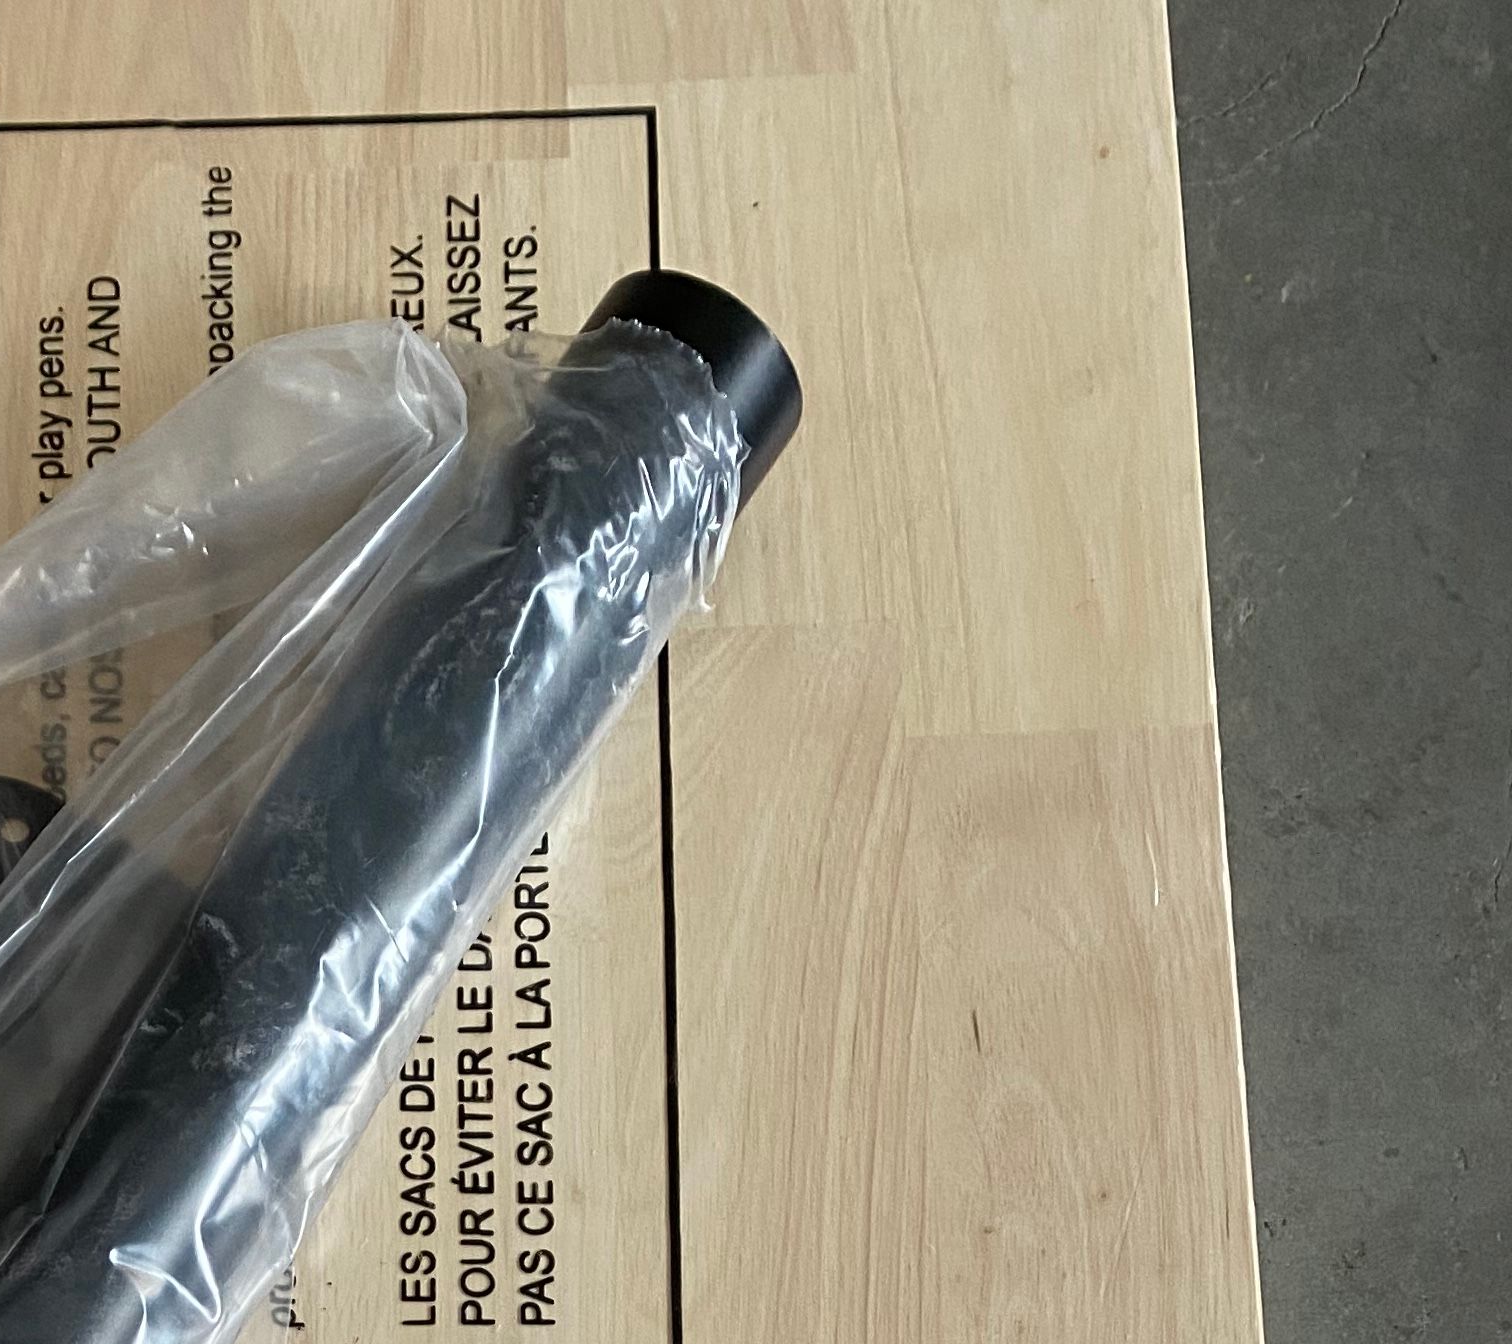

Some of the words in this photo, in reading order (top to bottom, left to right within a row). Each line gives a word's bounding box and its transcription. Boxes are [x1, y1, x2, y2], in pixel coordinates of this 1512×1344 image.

[201, 164, 233, 217] the
[38, 305, 72, 397] pens.
[87, 274, 121, 356] AND
[31, 410, 72, 479] play
[456, 985, 493, 1033] LE
[515, 977, 552, 1029] LA
[398, 1057, 435, 1112] DE
[508, 1040, 552, 1070] À
[449, 1046, 495, 1193] ÉVITER
[517, 1081, 553, 1166] SAC
[398, 1126, 436, 1236] SACS
[517, 1179, 554, 1235] CE
[399, 1248, 436, 1325] LES
[458, 1208, 496, 1325] POUR
[518, 1249, 555, 1326] PAS
